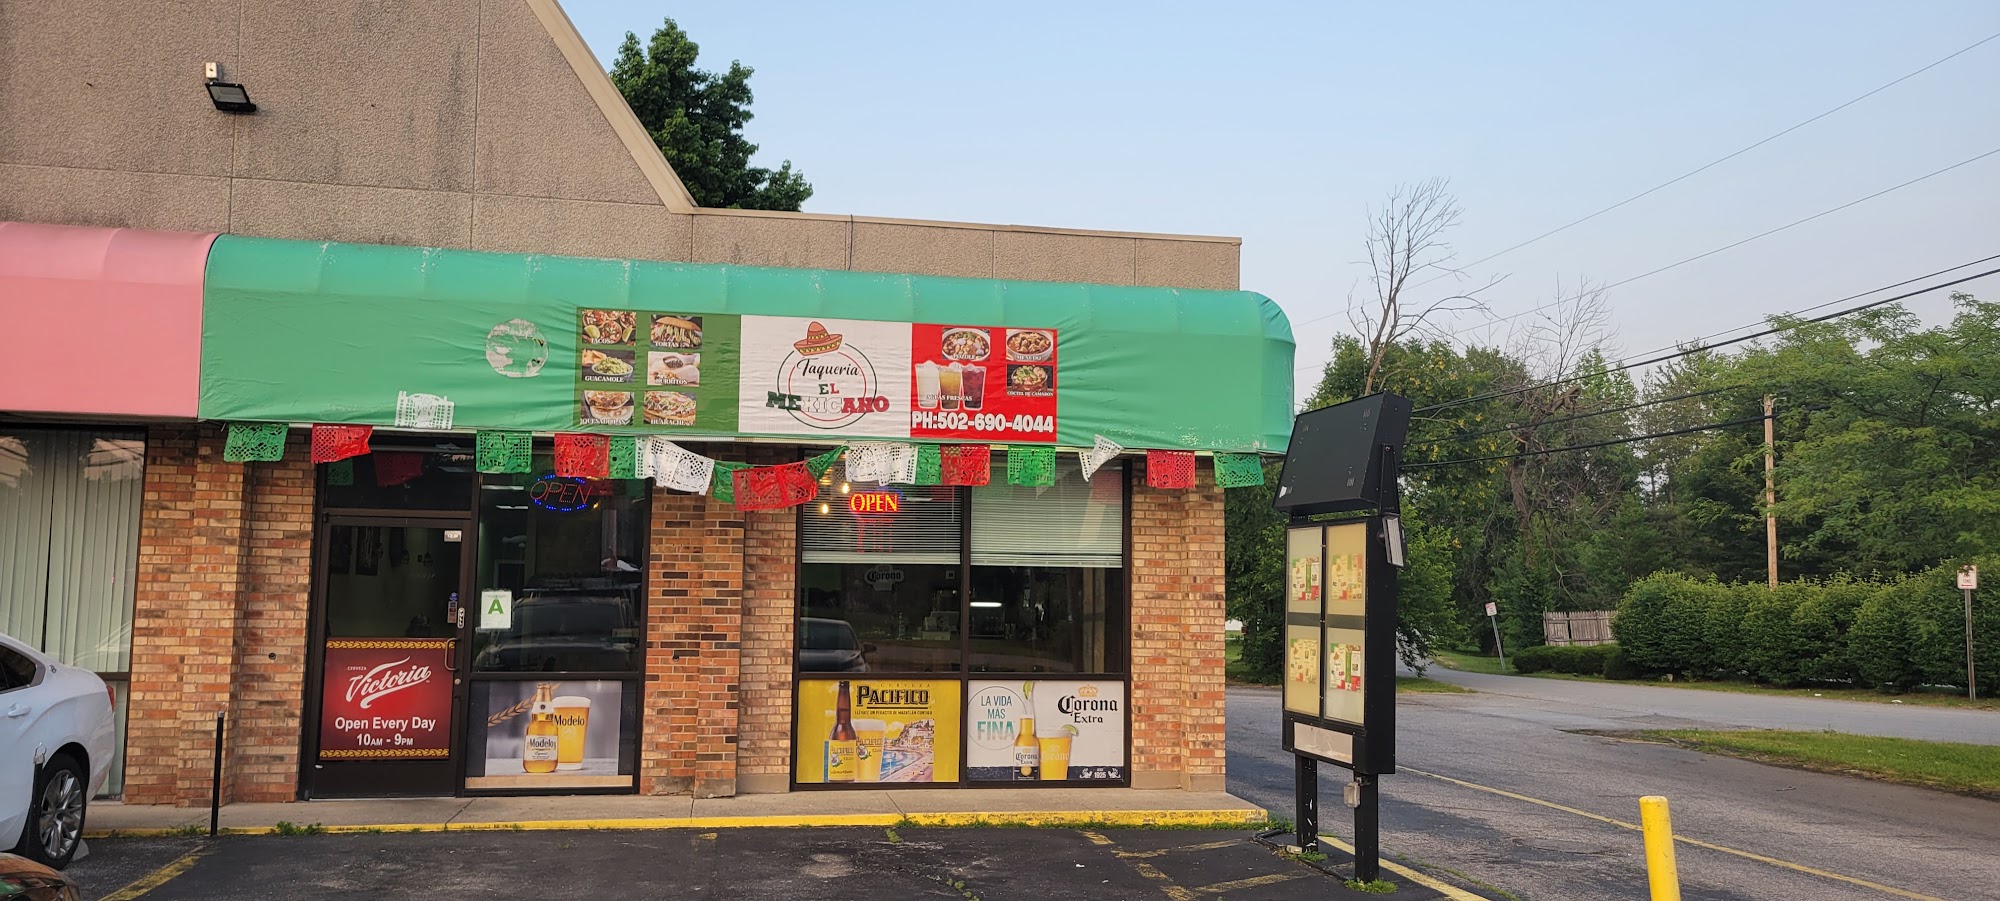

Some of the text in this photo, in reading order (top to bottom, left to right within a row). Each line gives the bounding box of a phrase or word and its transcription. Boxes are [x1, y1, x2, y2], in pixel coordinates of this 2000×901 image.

[591, 337, 612, 345] TACOS
[655, 340, 680, 349] TORTAS
[953, 353, 976, 361] POZOLE
[796, 357, 861, 380] Taqueria
[584, 374, 625, 384] GUACAMOLE
[818, 383, 840, 396] EL
[766, 390, 890, 414] MEXICANO
[946, 394, 973, 402] FRESCAS
[911, 411, 1054, 433] PH:502-690-4044
[529, 480, 593, 505] OPEN
[849, 492, 899, 513] OPEN
[866, 569, 903, 582] Corona
[487, 598, 505, 615] A
[345, 655, 432, 710] Victoria
[856, 685, 930, 707] PACIFICO
[980, 695, 1013, 707] LA VIDA
[1057, 695, 1118, 717] Corona
[987, 706, 1006, 720] MÁS
[1073, 712, 1104, 724] Extra
[334, 716, 436, 733] Open Every Day
[554, 714, 585, 726] Modelo
[977, 721, 1014, 740] FINA
[356, 733, 383, 746] 10AM
[394, 733, 414, 746] 9PM
[529, 738, 554, 748] Modelo
[1015, 752, 1038, 761] Corona
[1094, 771, 1107, 779] 1925
